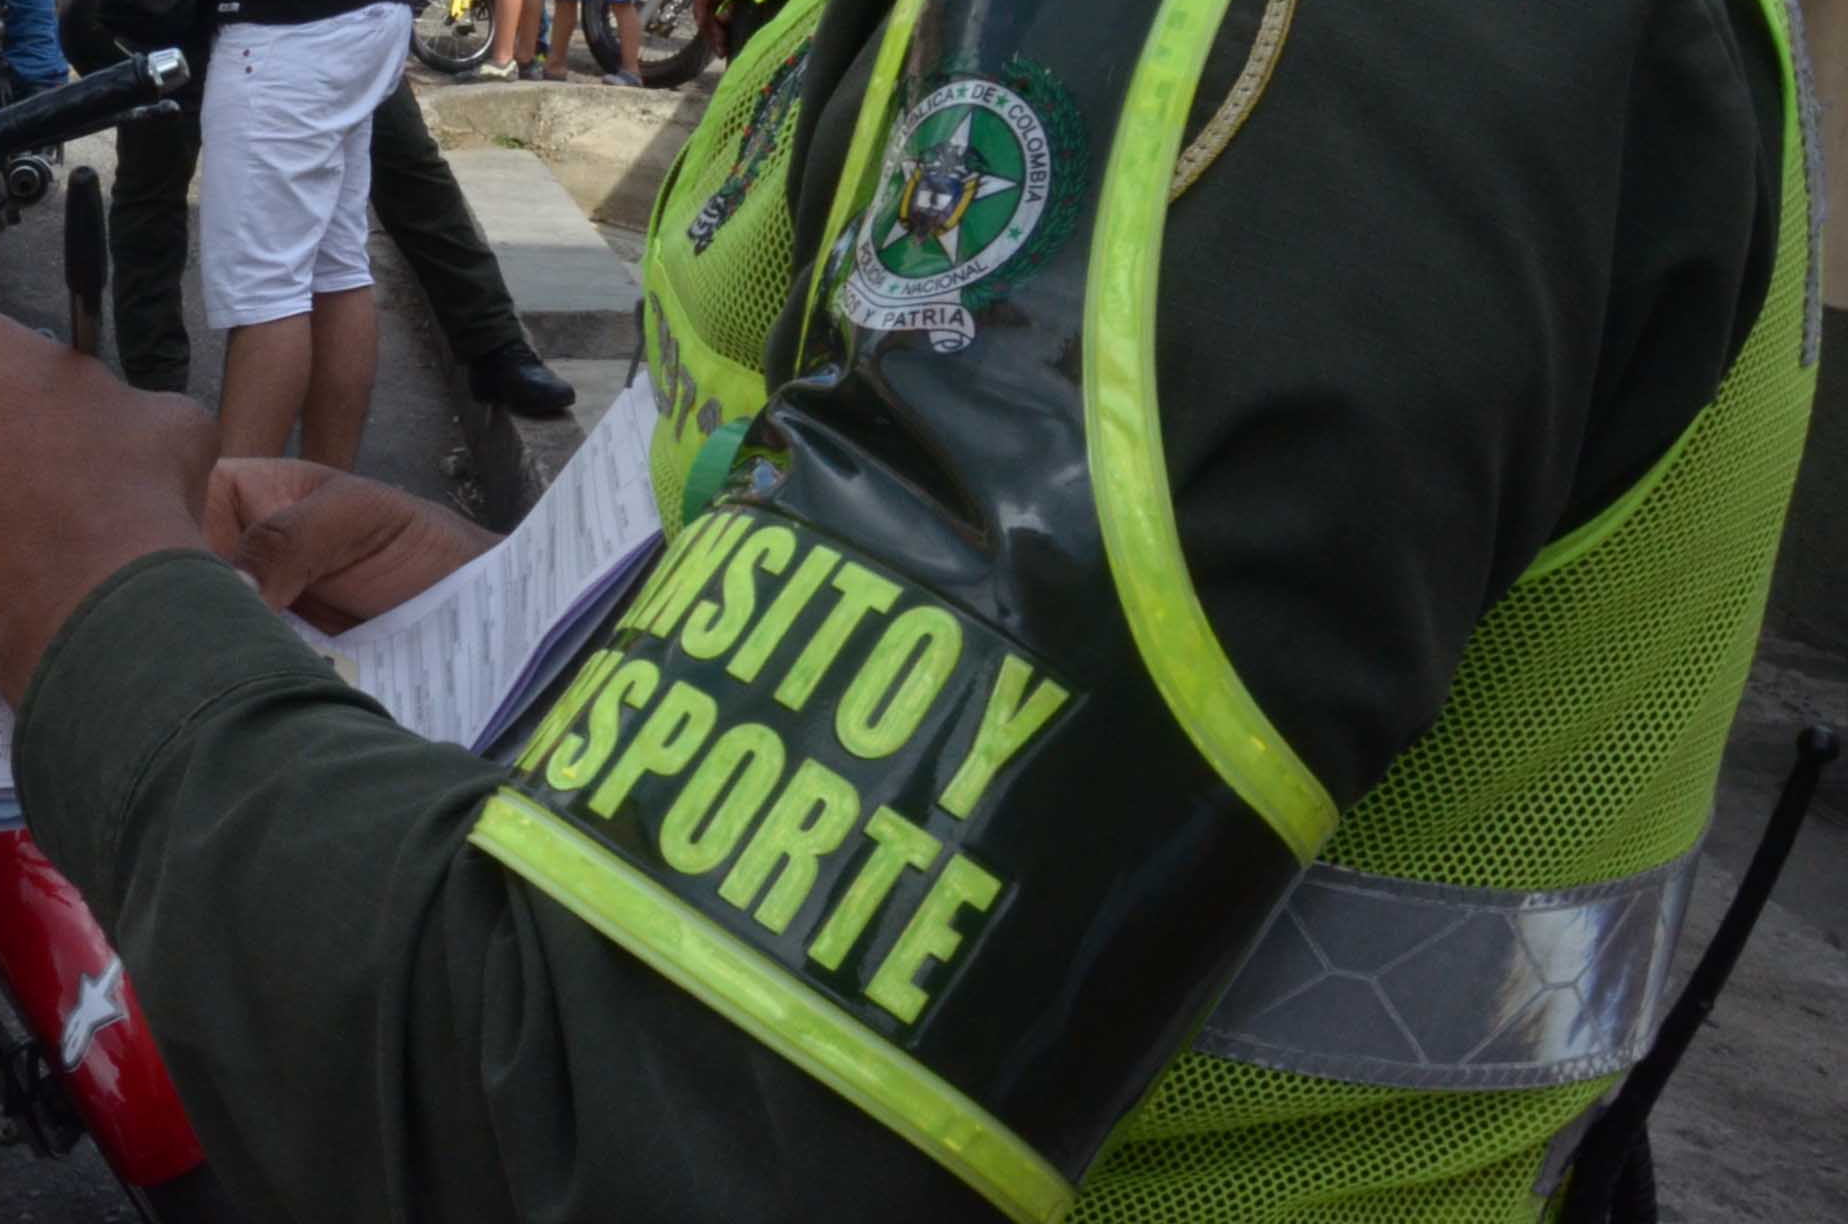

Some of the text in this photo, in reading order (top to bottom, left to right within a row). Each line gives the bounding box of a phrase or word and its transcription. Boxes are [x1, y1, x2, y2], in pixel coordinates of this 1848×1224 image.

[970, 83, 996, 104] DE
[1007, 103, 1044, 204] COLOMBIA
[901, 262, 988, 296] NACIONAL
[881, 308, 965, 328] PATRIA
[937, 652, 1071, 821] Y
